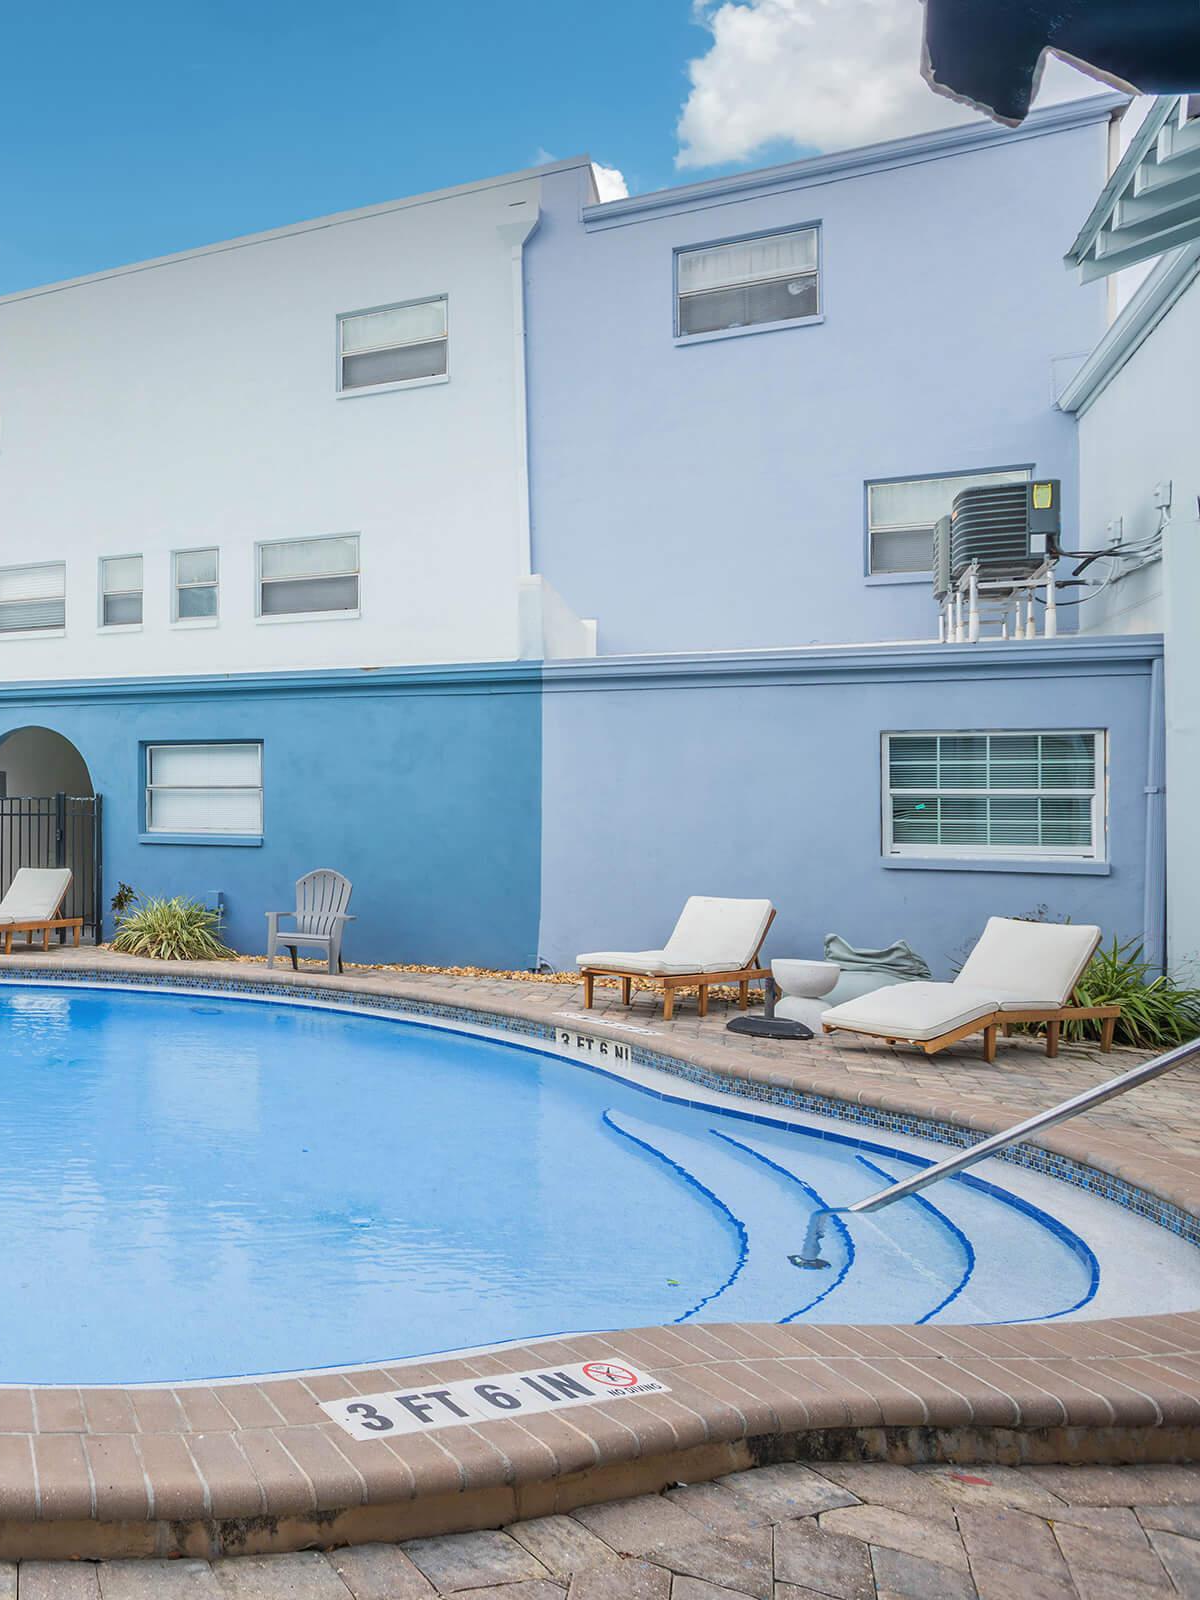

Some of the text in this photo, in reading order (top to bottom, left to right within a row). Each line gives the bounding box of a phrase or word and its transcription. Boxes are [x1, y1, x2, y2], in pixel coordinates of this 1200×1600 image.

[576, 1036, 595, 1050] FT
[600, 1042, 608, 1055] 6
[606, 1382, 662, 1397] NO DIVING
[345, 1371, 596, 1431] 3 FT 6 IN
